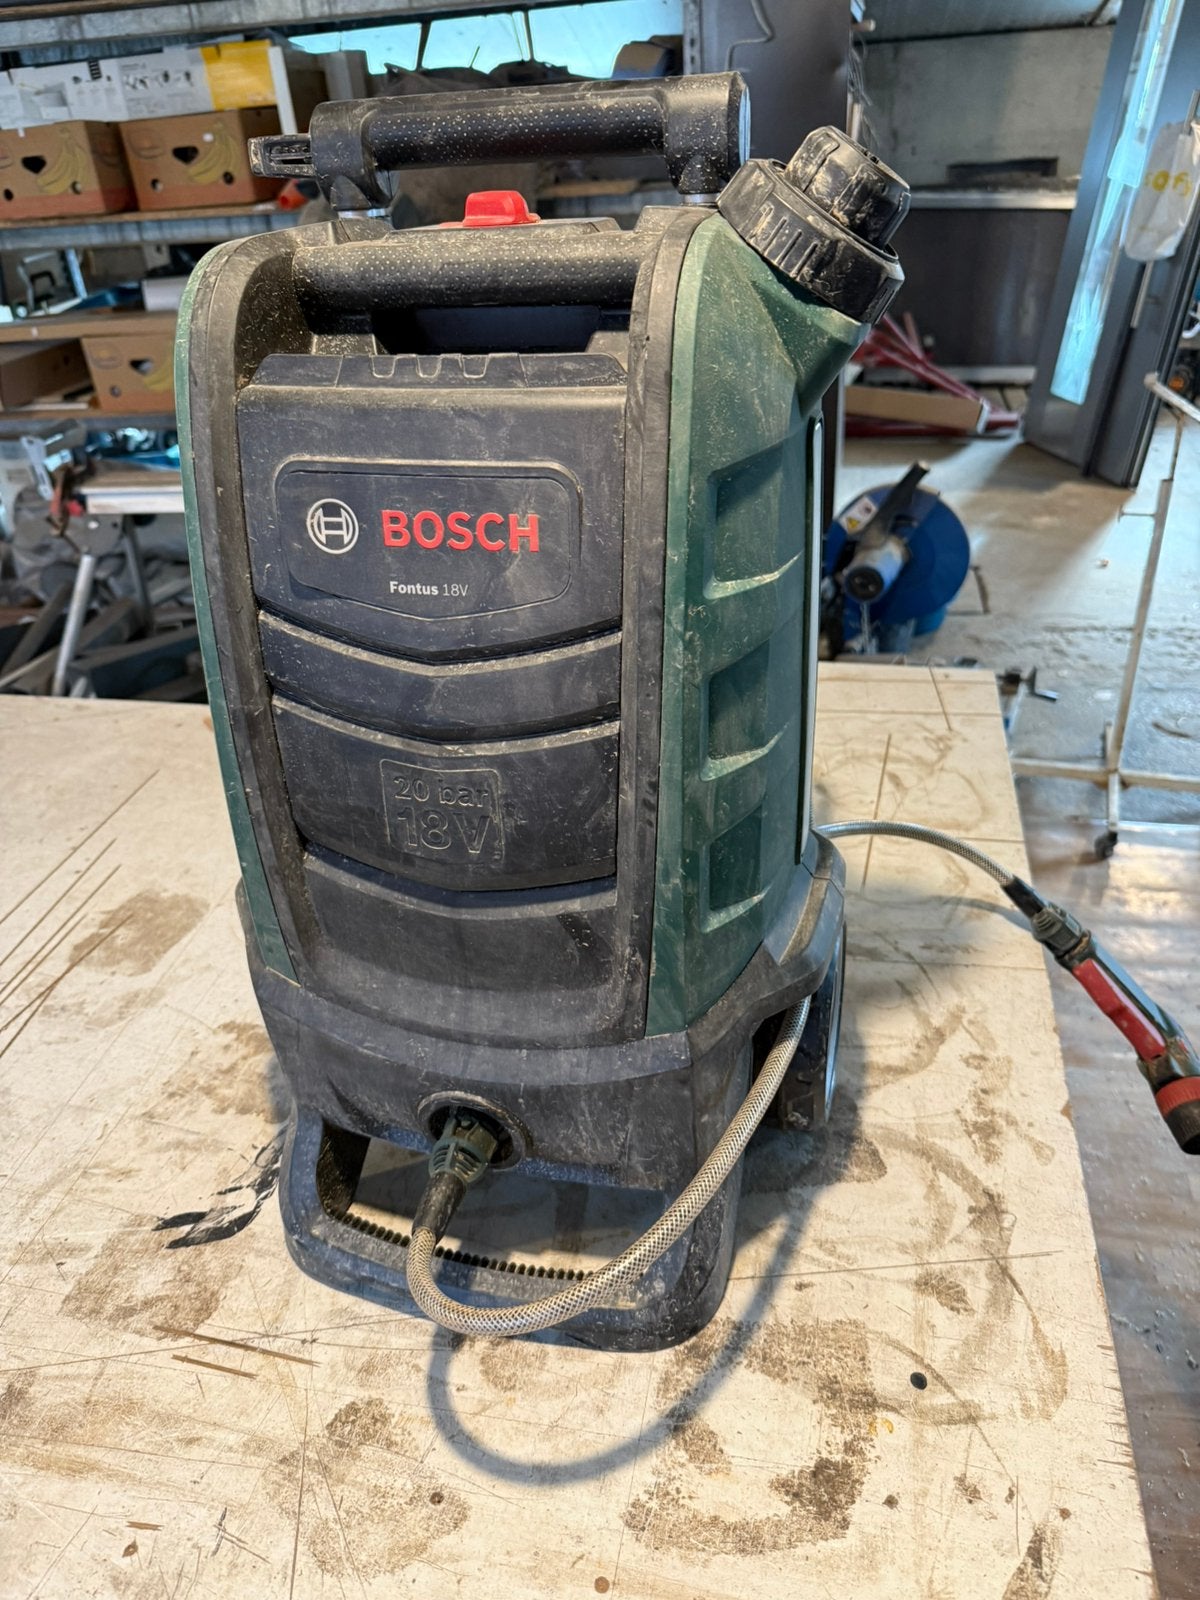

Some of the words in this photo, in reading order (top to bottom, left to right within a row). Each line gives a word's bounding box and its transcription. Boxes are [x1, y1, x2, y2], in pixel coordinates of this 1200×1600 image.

[381, 509, 540, 553] BOSCH
[389, 581, 440, 596] Fontus
[442, 583, 469, 597] 18V
[393, 776, 431, 802] 20
[438, 778, 489, 808] bar
[397, 806, 491, 854] 18V
